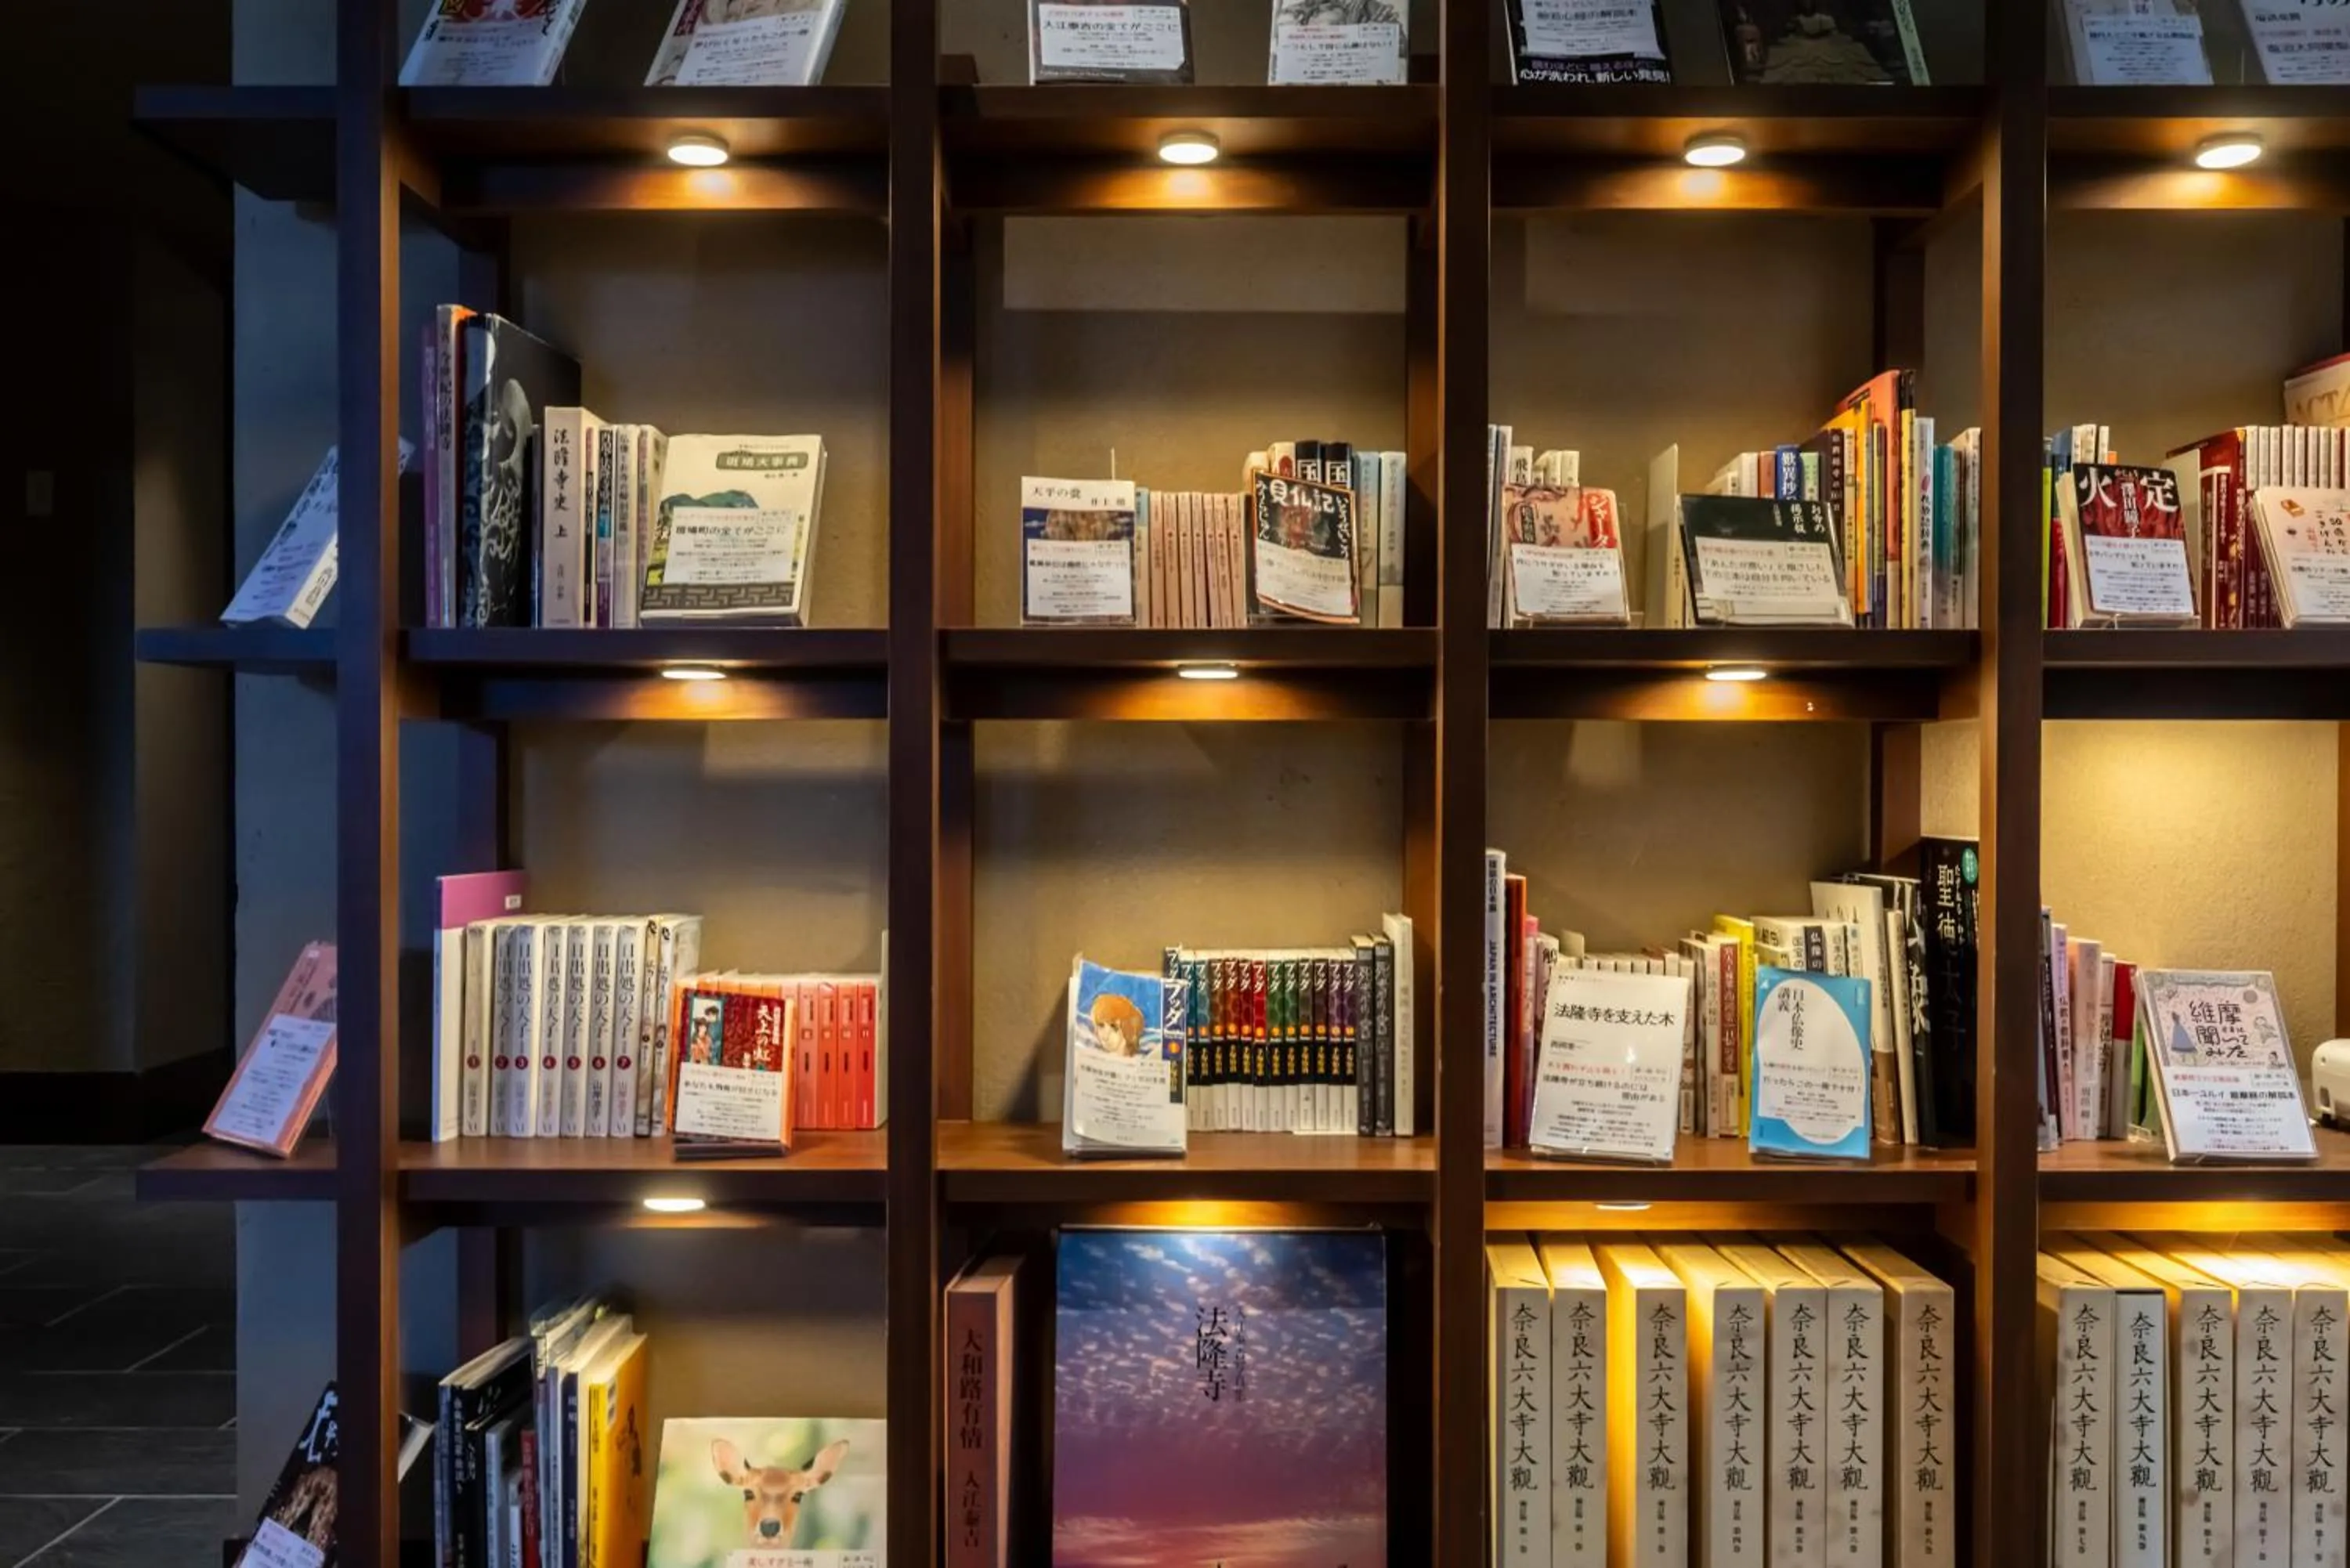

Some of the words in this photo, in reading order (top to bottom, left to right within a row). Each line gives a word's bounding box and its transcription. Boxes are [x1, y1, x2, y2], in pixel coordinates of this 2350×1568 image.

[554, 428, 569, 511] 法隆寺史
[555, 524, 567, 537] 上
[1165, 981, 1184, 1028] ブッダ
[1488, 940, 1497, 970] JAPAN
[1488, 985, 1497, 1057] ARCHITECTURE
[1553, 1003, 1676, 1027] 法隆寺を支えた木
[2189, 1001, 2241, 1024] 維摩
[960, 1328, 983, 1449] 大和路有情
[1195, 1307, 1227, 1401] 法隆寺
[1510, 1303, 1538, 1490] 奈良六大寺大觀
[1567, 1301, 1595, 1489] 奈良六大寺大觀
[1648, 1303, 1676, 1491] 奈良六大寺大觀
[1725, 1303, 1753, 1491] 奈良六大寺大觀
[1788, 1303, 1817, 1491] 奈良六大寺大觀
[1841, 1303, 1870, 1491] 奈良六大寺大觀
[1915, 1304, 1943, 1491] 奈良六大寺大觀
[2070, 1303, 2100, 1491] 奈良六大寺大觀
[2128, 1311, 2157, 1487] 奈良六大寺大觀
[2194, 1304, 2223, 1492] 奈良六大寺大觀
[2250, 1304, 2280, 1493] 奈良六大寺大觀
[2306, 1305, 2337, 1493] 奈良六大寺大觀
